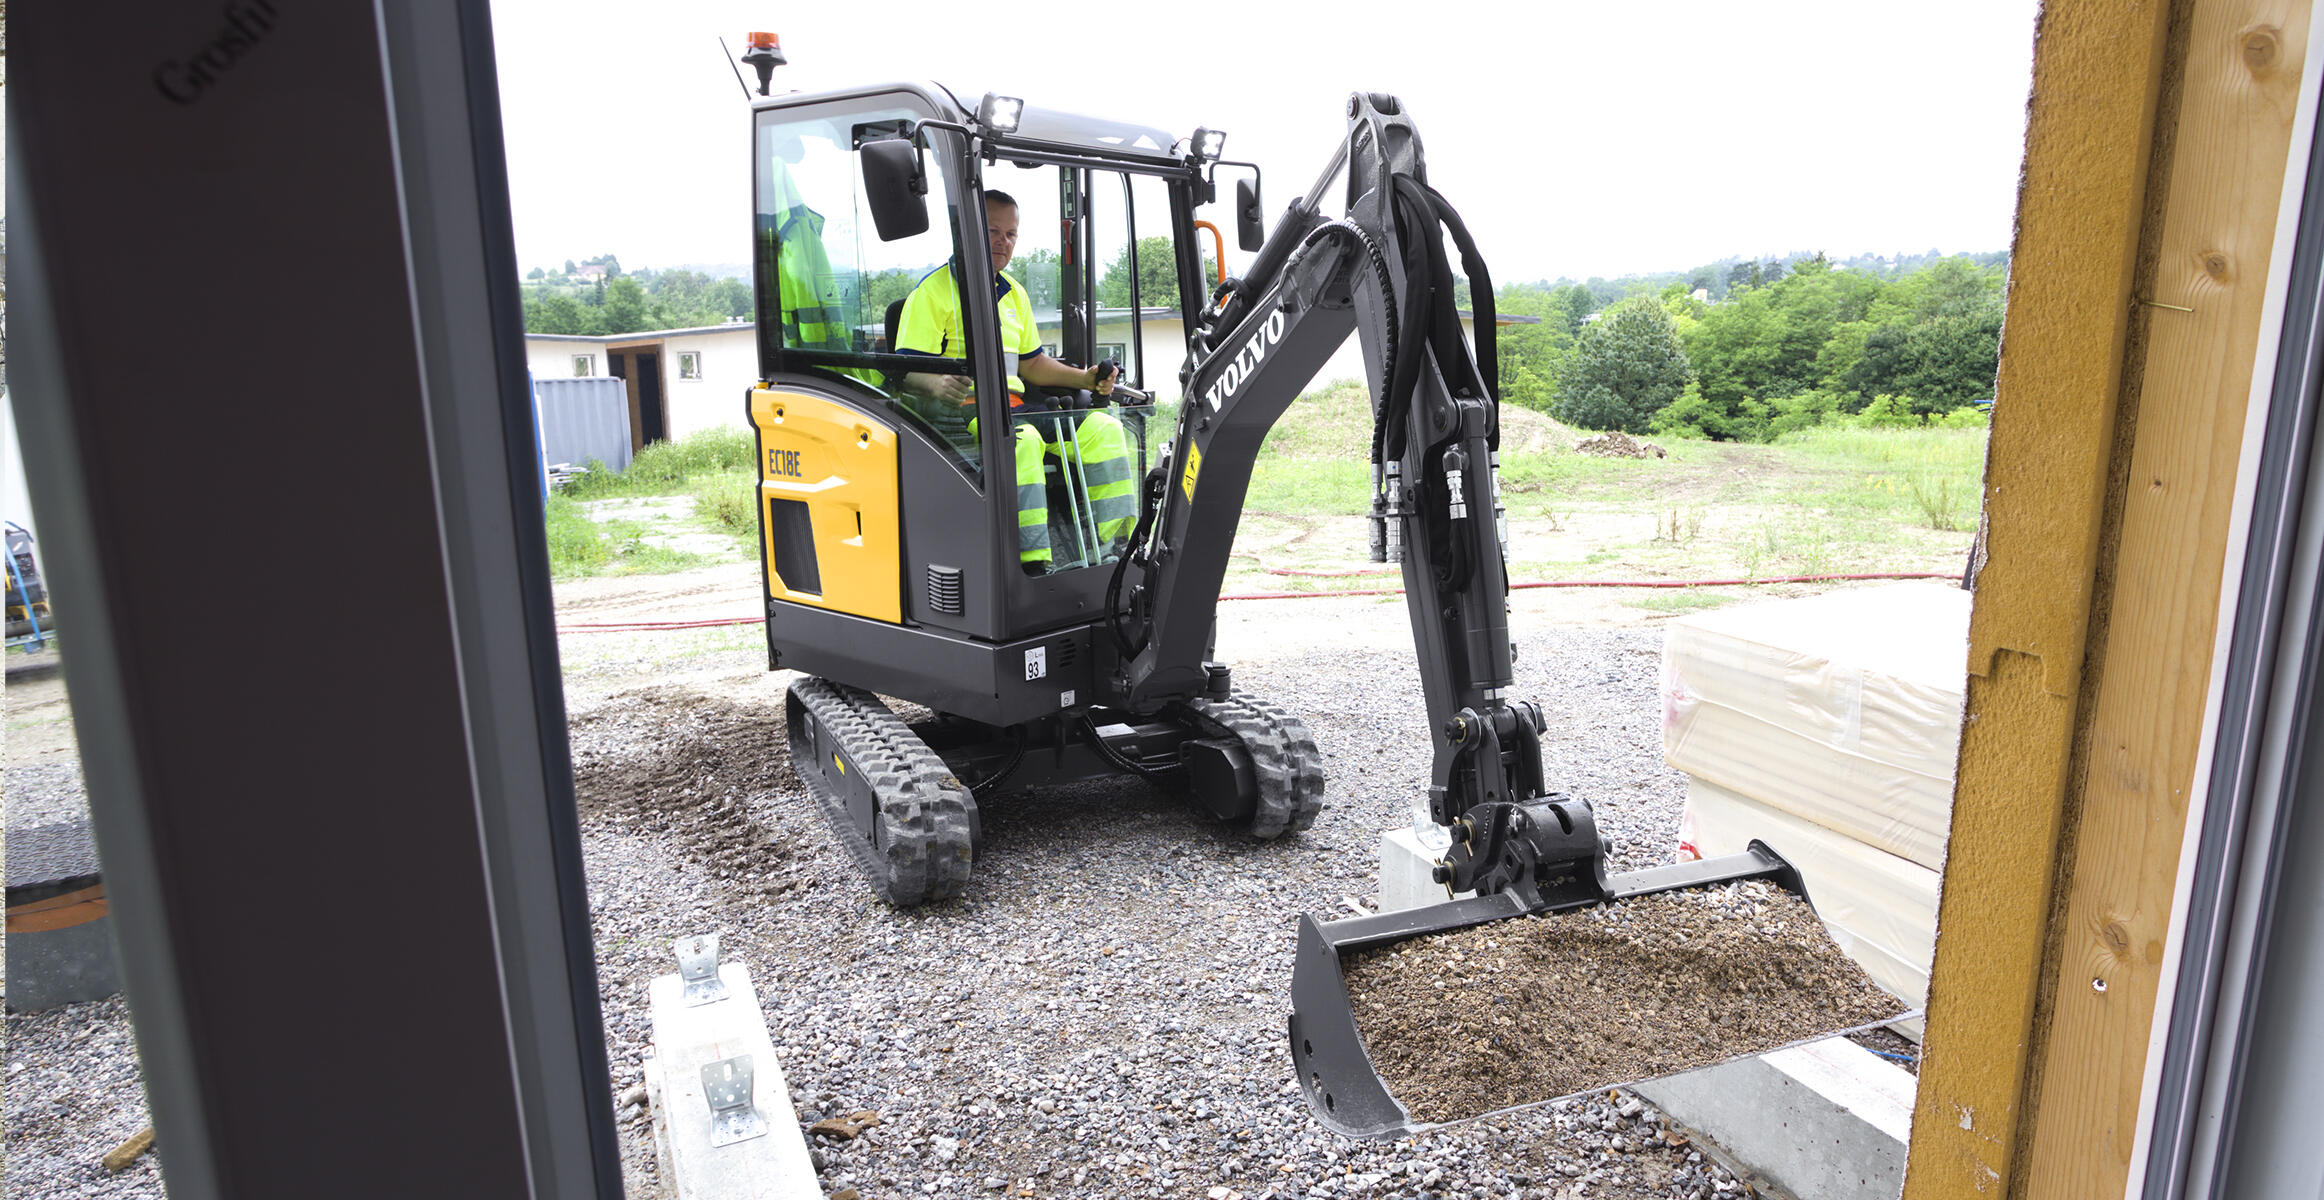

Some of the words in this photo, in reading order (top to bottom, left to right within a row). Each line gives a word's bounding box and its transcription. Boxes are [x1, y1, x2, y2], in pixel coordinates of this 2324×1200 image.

[1205, 308, 1285, 413] VOLVO
[768, 447, 802, 477] EC18E
[1028, 661, 1039, 679] 93
